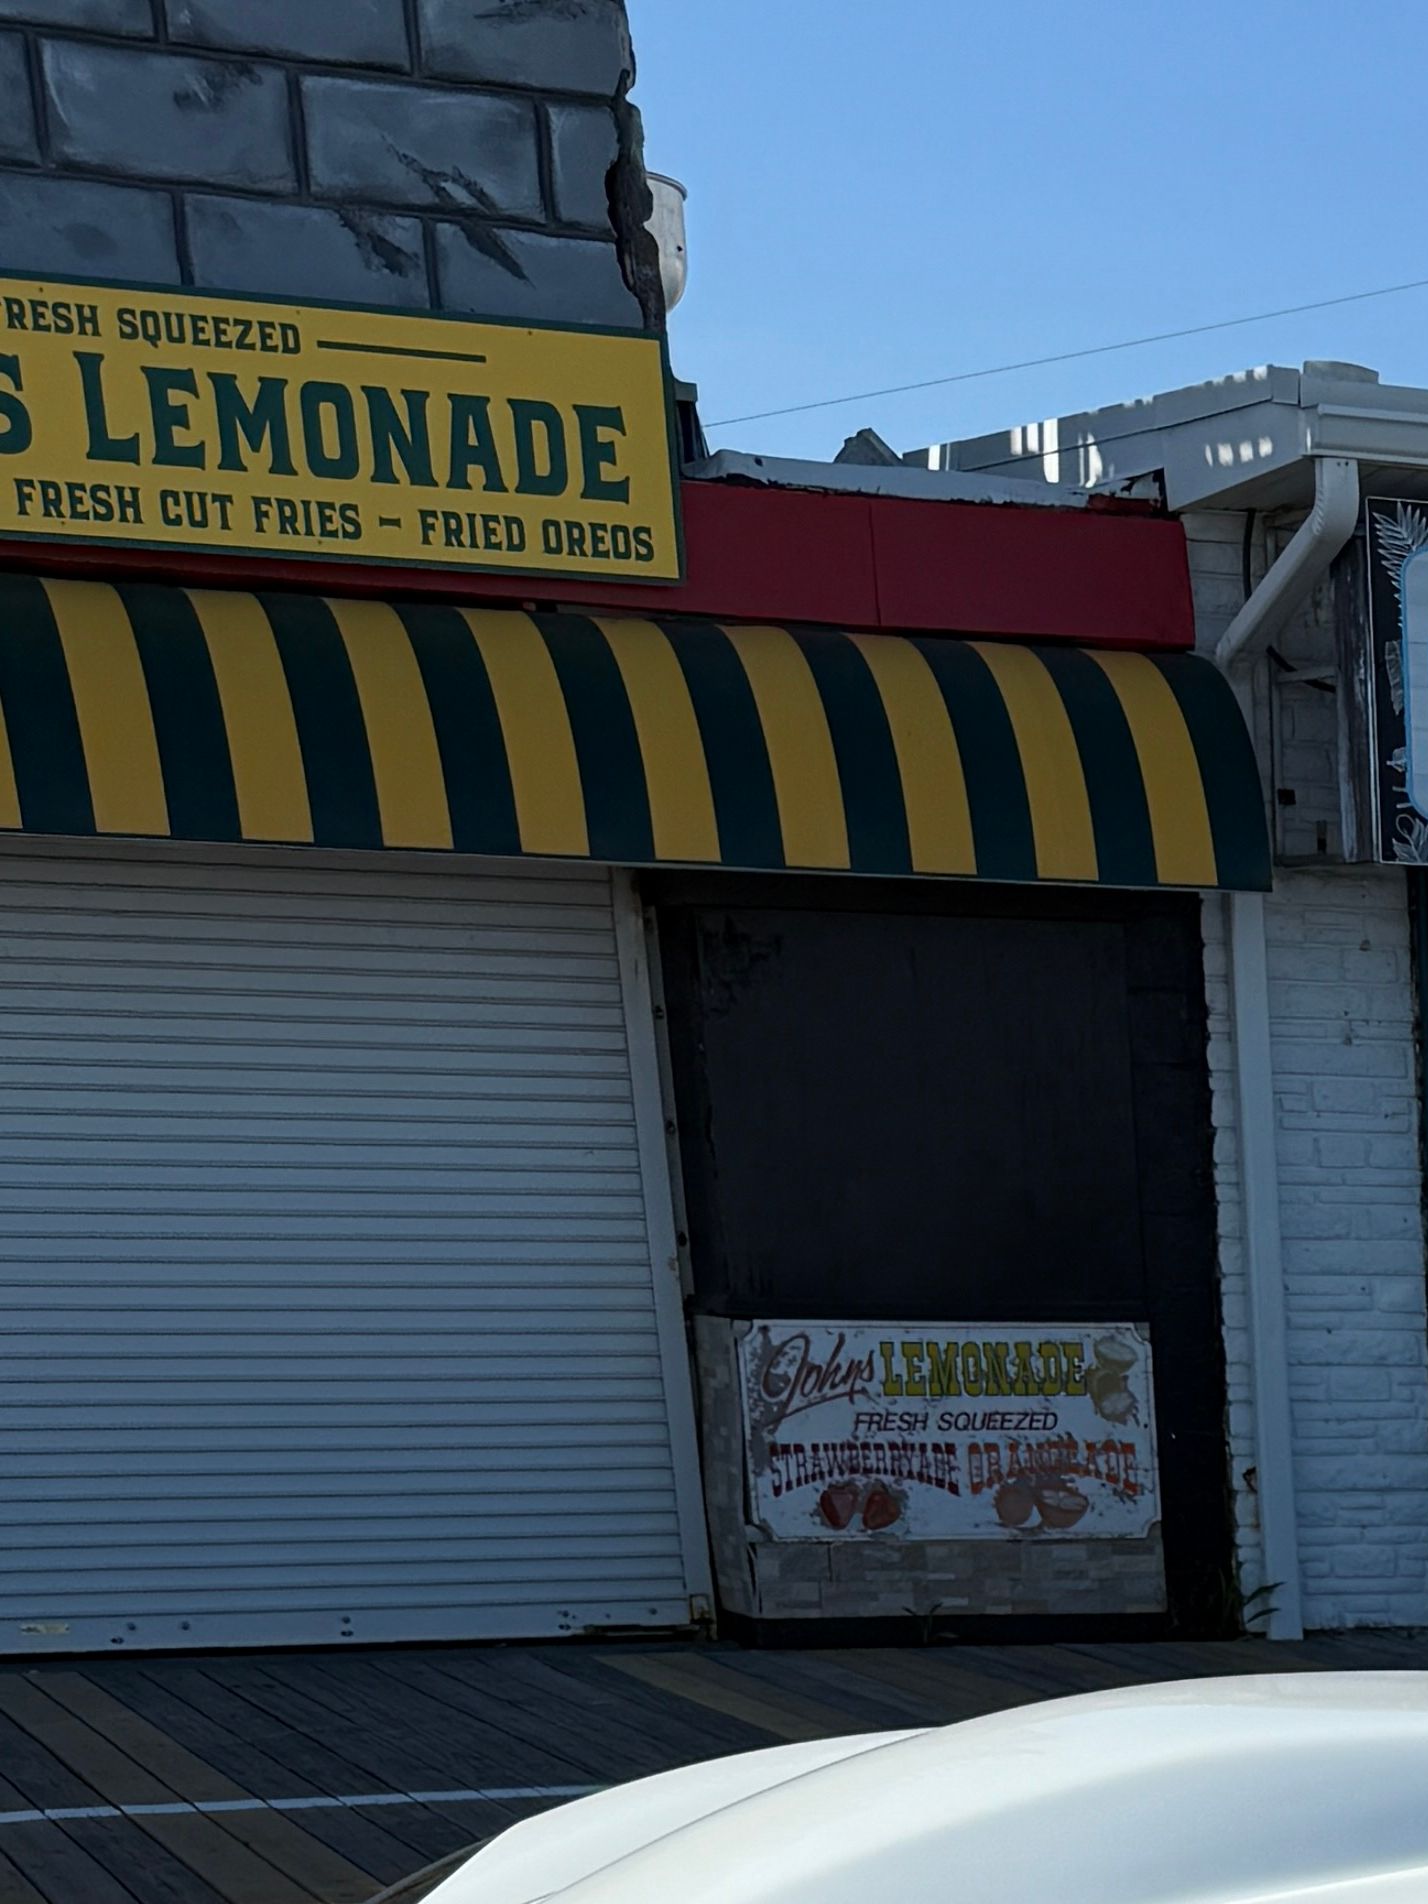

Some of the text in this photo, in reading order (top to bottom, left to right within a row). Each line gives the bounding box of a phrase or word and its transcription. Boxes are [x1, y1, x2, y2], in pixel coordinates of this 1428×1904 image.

[0, 296, 301, 355] RESH SQUEEZED
[72, 352, 631, 504] LEMONADE
[14, 478, 144, 526] FRESH
[160, 491, 233, 531] CUT
[252, 497, 362, 541] FRIES
[419, 509, 525, 553] FRIED
[543, 520, 655, 562] OREOS
[879, 1341, 1088, 1397] LEMONADE
[854, 1411, 1058, 1432] FRESH SQUEEZED
[768, 1440, 961, 1497] STRAWBERRYADE
